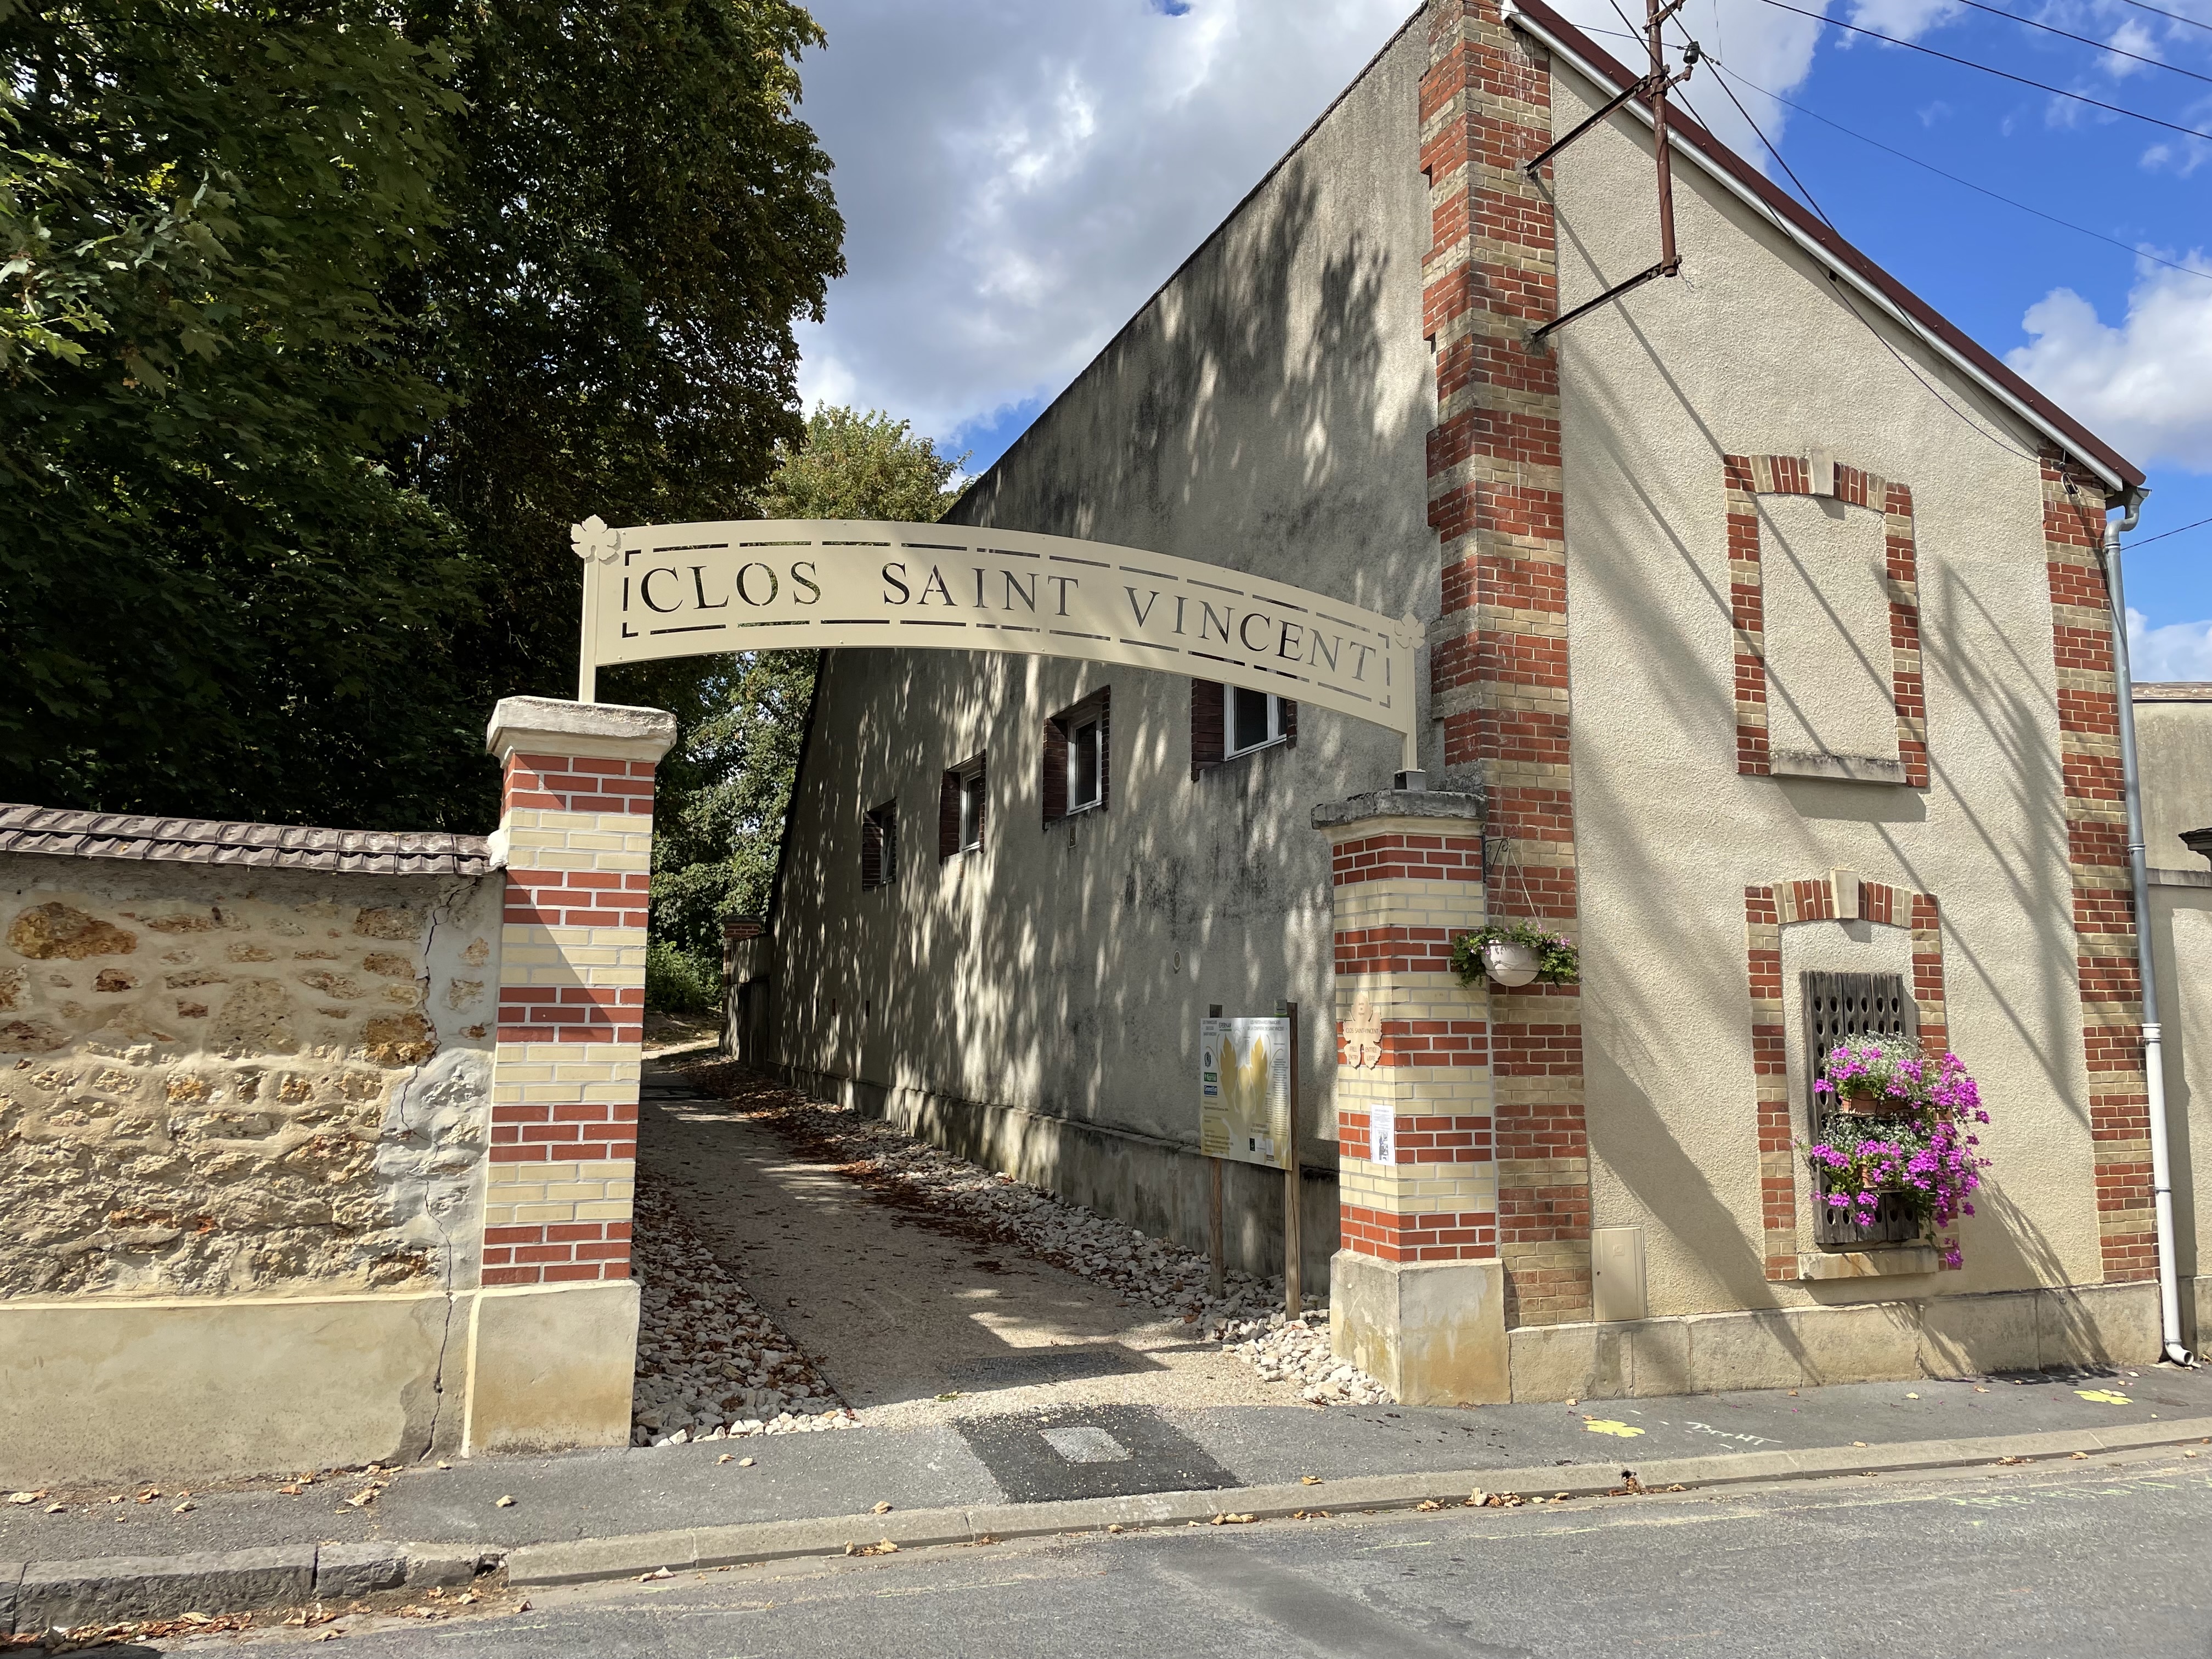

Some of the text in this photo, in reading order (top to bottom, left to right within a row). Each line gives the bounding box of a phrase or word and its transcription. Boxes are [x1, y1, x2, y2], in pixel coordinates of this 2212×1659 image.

[639, 561, 1378, 682] CLOS SAINT VINCENT
